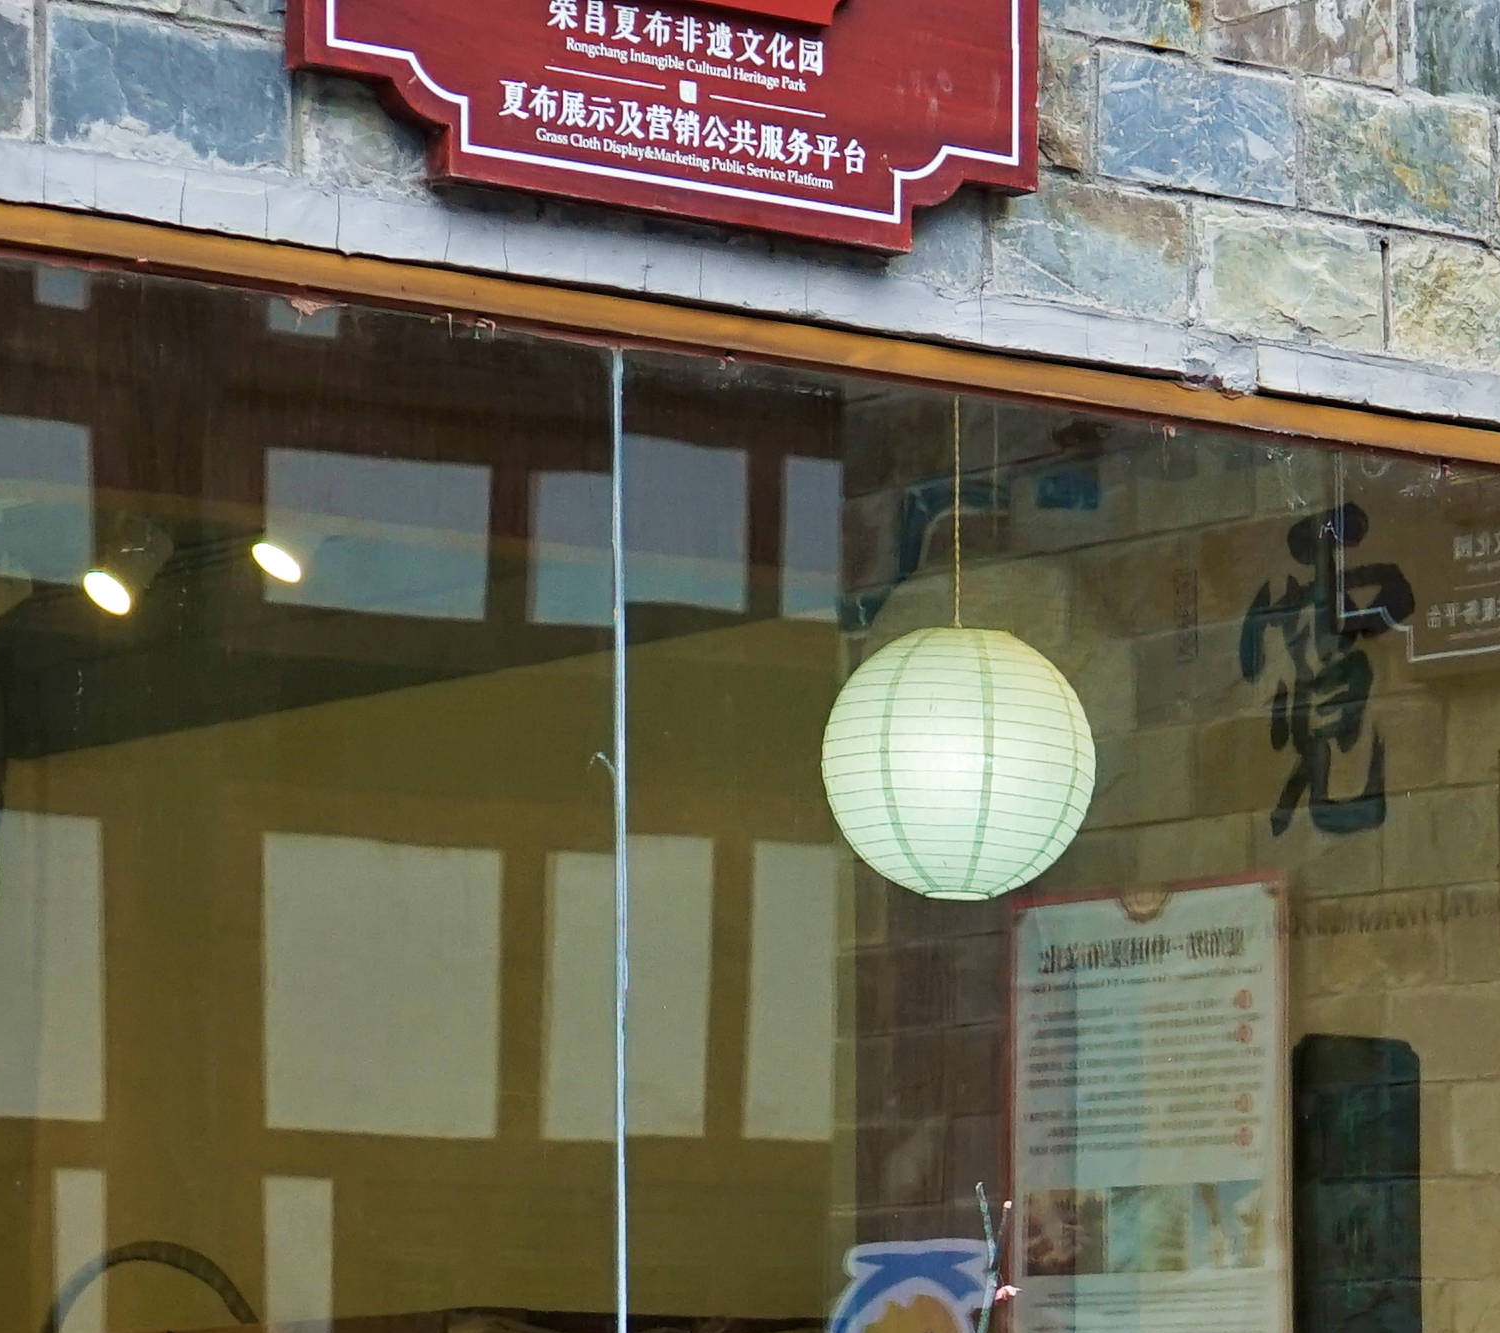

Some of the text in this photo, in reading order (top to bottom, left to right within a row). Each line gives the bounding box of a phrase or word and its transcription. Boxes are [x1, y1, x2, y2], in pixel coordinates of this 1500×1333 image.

[547, 0, 823, 76] 荣昌夏布非遗文化园
[566, 36, 806, 92] Rongchang Intangible Cultural Heritage Park
[499, 82, 867, 175] 夏布展示及营销公共服务平台
[536, 126, 832, 190] Grass Cloth Display&Marketing Public Service Platform
